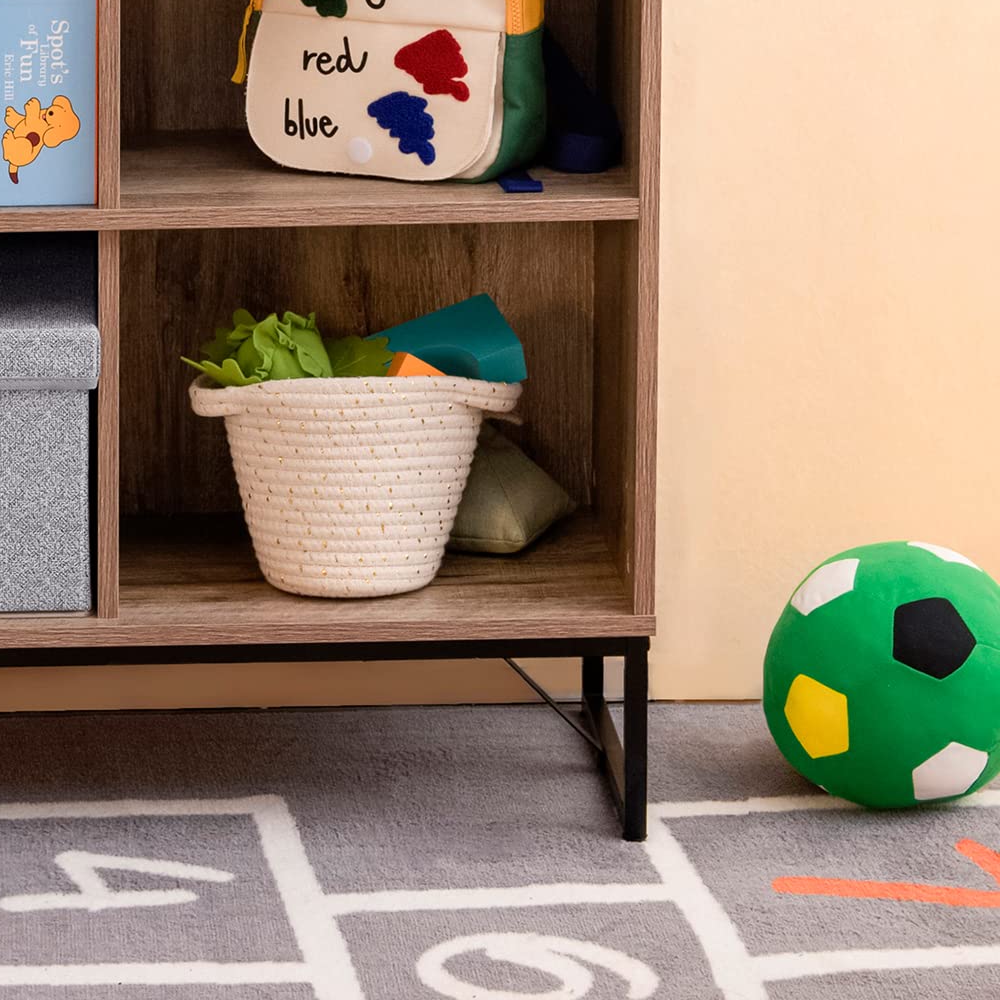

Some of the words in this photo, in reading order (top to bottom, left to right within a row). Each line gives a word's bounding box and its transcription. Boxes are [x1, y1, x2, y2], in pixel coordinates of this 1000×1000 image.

[27, 24, 38, 36] of
[4, 54, 15, 78] Eric
[19, 38, 39, 82] Fun
[39, 44, 50, 87] Library
[50, 19, 70, 85] Spot's
[302, 36, 368, 74] red
[4, 79, 15, 101] Hill
[284, 97, 338, 140] blue
[0, 849, 235, 913] 4
